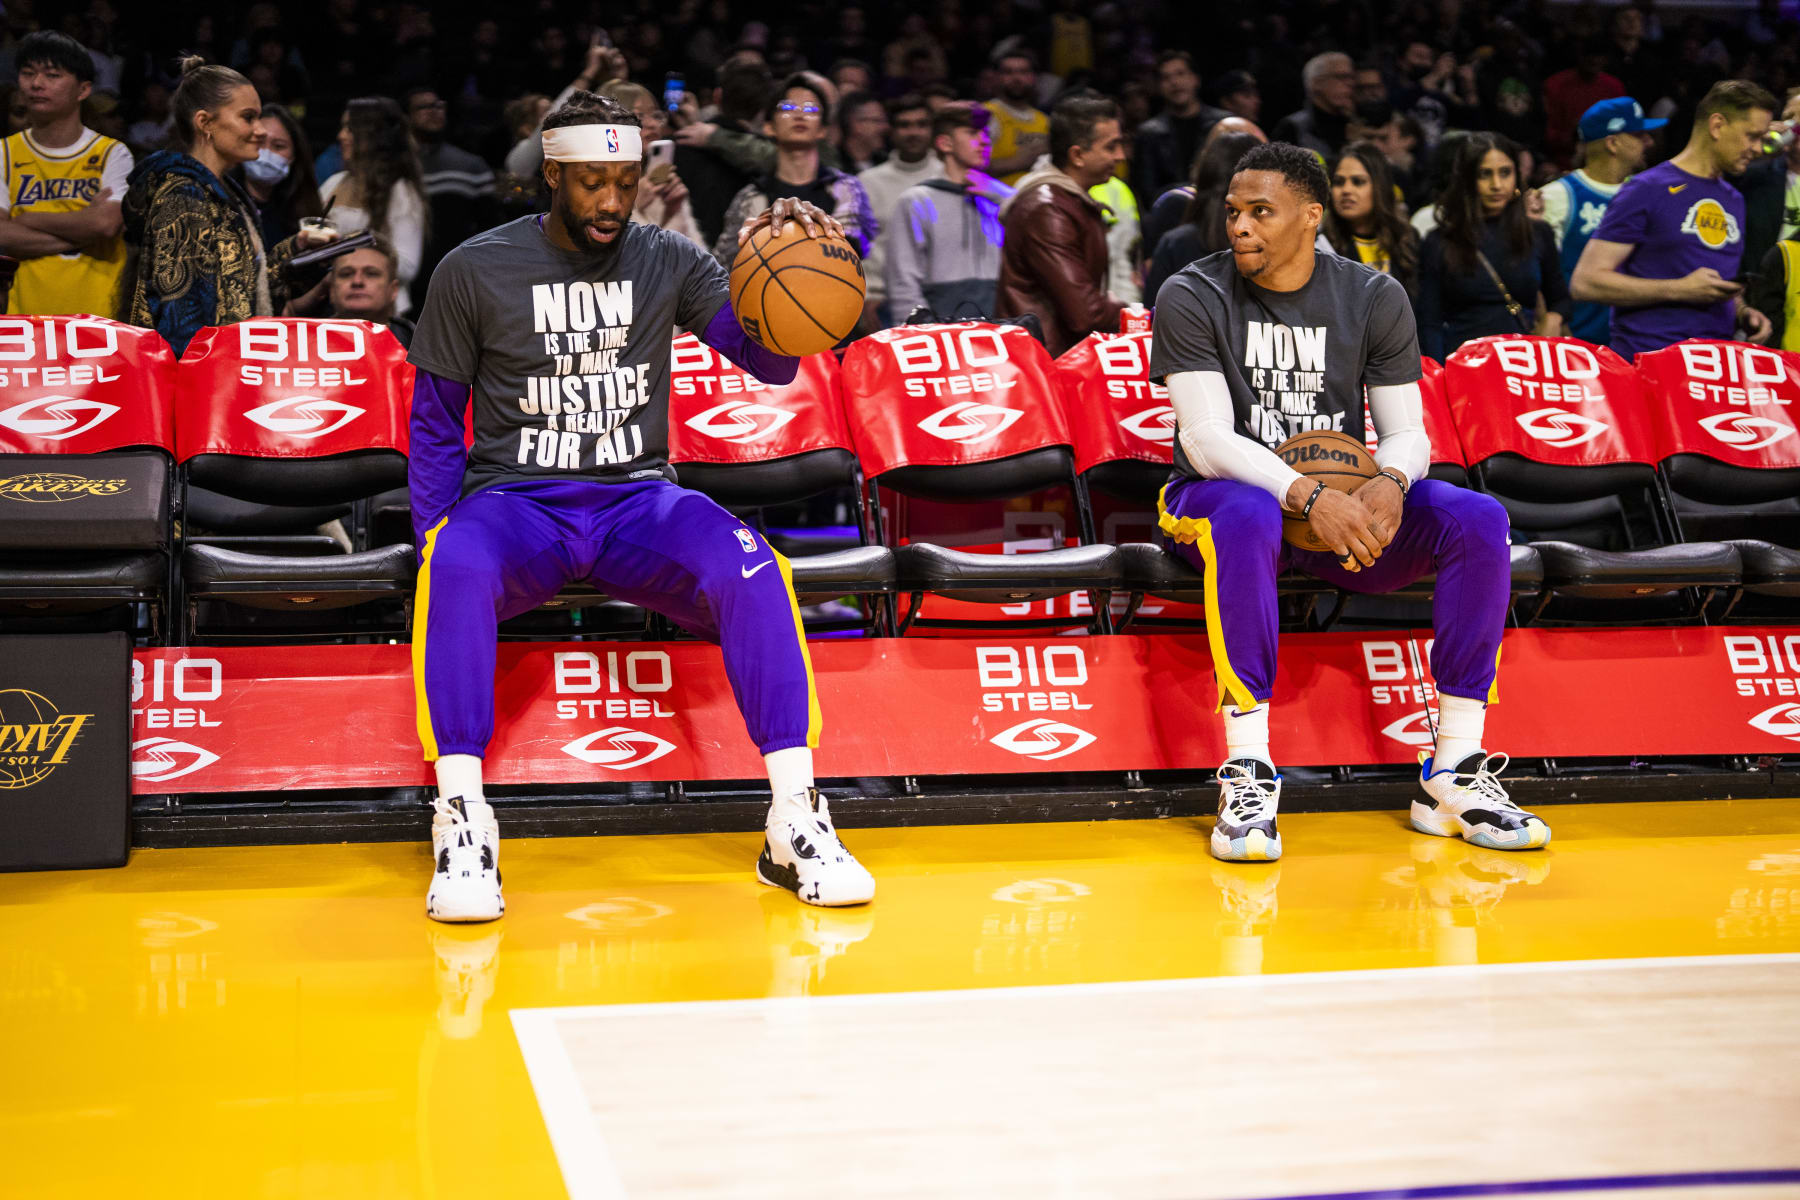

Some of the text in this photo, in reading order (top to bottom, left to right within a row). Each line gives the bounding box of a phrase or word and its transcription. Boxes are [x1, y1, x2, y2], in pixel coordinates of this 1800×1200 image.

[16, 174, 101, 205] LAKERS
[532, 280, 633, 333] NOW
[0, 320, 119, 361] BIO
[239, 322, 367, 362] BIO
[544, 326, 629, 355] IS THE TIME
[890, 329, 1010, 374] BIO
[1245, 321, 1327, 372] NOW
[554, 349, 620, 376] TO MAKE
[1493, 340, 1601, 380] BIO
[1679, 344, 1787, 384] BIO
[240, 365, 367, 387] STEEL
[518, 363, 650, 416] JUSTICE
[673, 373, 789, 396] STEE
[904, 372, 1017, 398] STEEL
[1106, 380, 1168, 399] STE
[1252, 368, 1266, 389] IS
[1294, 371, 1325, 392] TIME
[1506, 375, 1606, 403] STEEL
[1259, 390, 1276, 409] TO
[1688, 381, 1792, 406] STEEL
[547, 408, 631, 434] A REALITY
[517, 427, 581, 469] FOR
[554, 651, 673, 694] BIO
[976, 645, 1089, 688] BIO
[1362, 639, 1435, 681] BI
[1372, 682, 1440, 704] STE
[1736, 678, 1800, 696] STE
[556, 698, 676, 720] STEEL
[982, 691, 1094, 712] STEEL
[132, 708, 223, 729] TEEL
